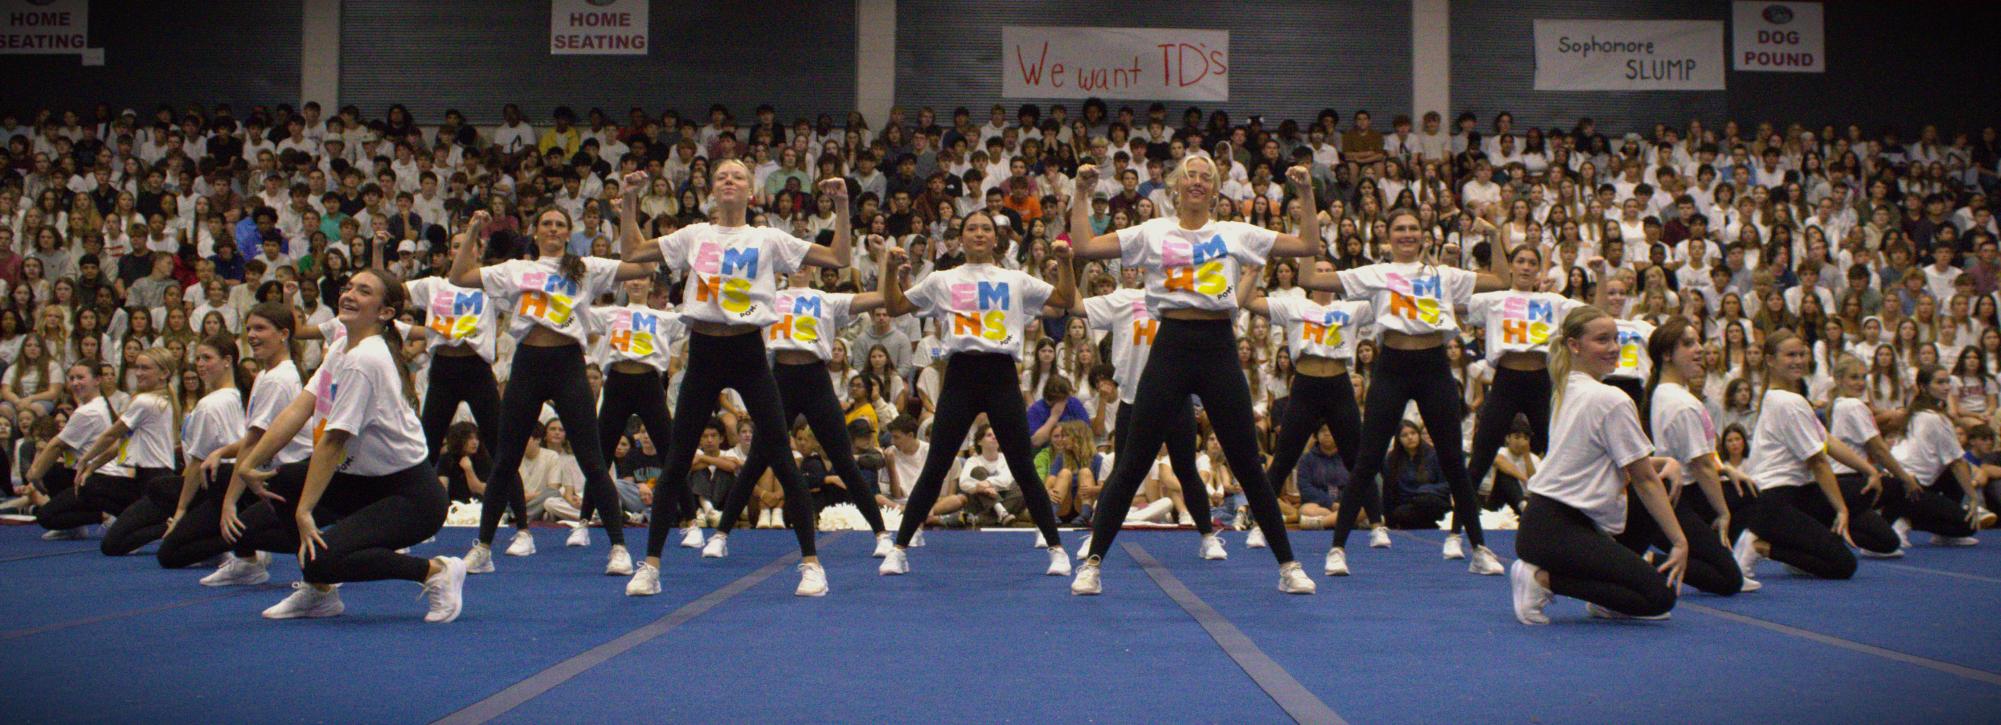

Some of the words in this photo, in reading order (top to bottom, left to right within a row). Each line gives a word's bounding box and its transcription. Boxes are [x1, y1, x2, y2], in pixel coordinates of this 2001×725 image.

[10, 12, 71, 26] HOME
[569, 12, 631, 27] HOME
[554, 34, 645, 49] SEATING
[1558, 35, 1654, 58] Sophomore
[1757, 30, 1801, 45] DOG
[1017, 41, 1064, 88] We
[1077, 55, 1142, 91] want
[1625, 59, 1697, 81] SLUMP
[1744, 51, 1815, 67] POUND
[695, 242, 759, 279] EM
[1162, 234, 1228, 267] EM
[522, 272, 577, 296] EM
[1164, 260, 1227, 295] HS
[1385, 272, 1441, 300] EM
[433, 290, 483, 316] EM
[519, 291, 572, 325] HS
[775, 295, 821, 319] EM
[951, 281, 1009, 311] EM
[1391, 291, 1440, 325] HS
[612, 310, 657, 334] EM
[1503, 296, 1553, 323] EM
[769, 314, 818, 342] HS
[955, 310, 1007, 341] HS
[1503, 319, 1549, 345] HS
[609, 329, 654, 355] HS
